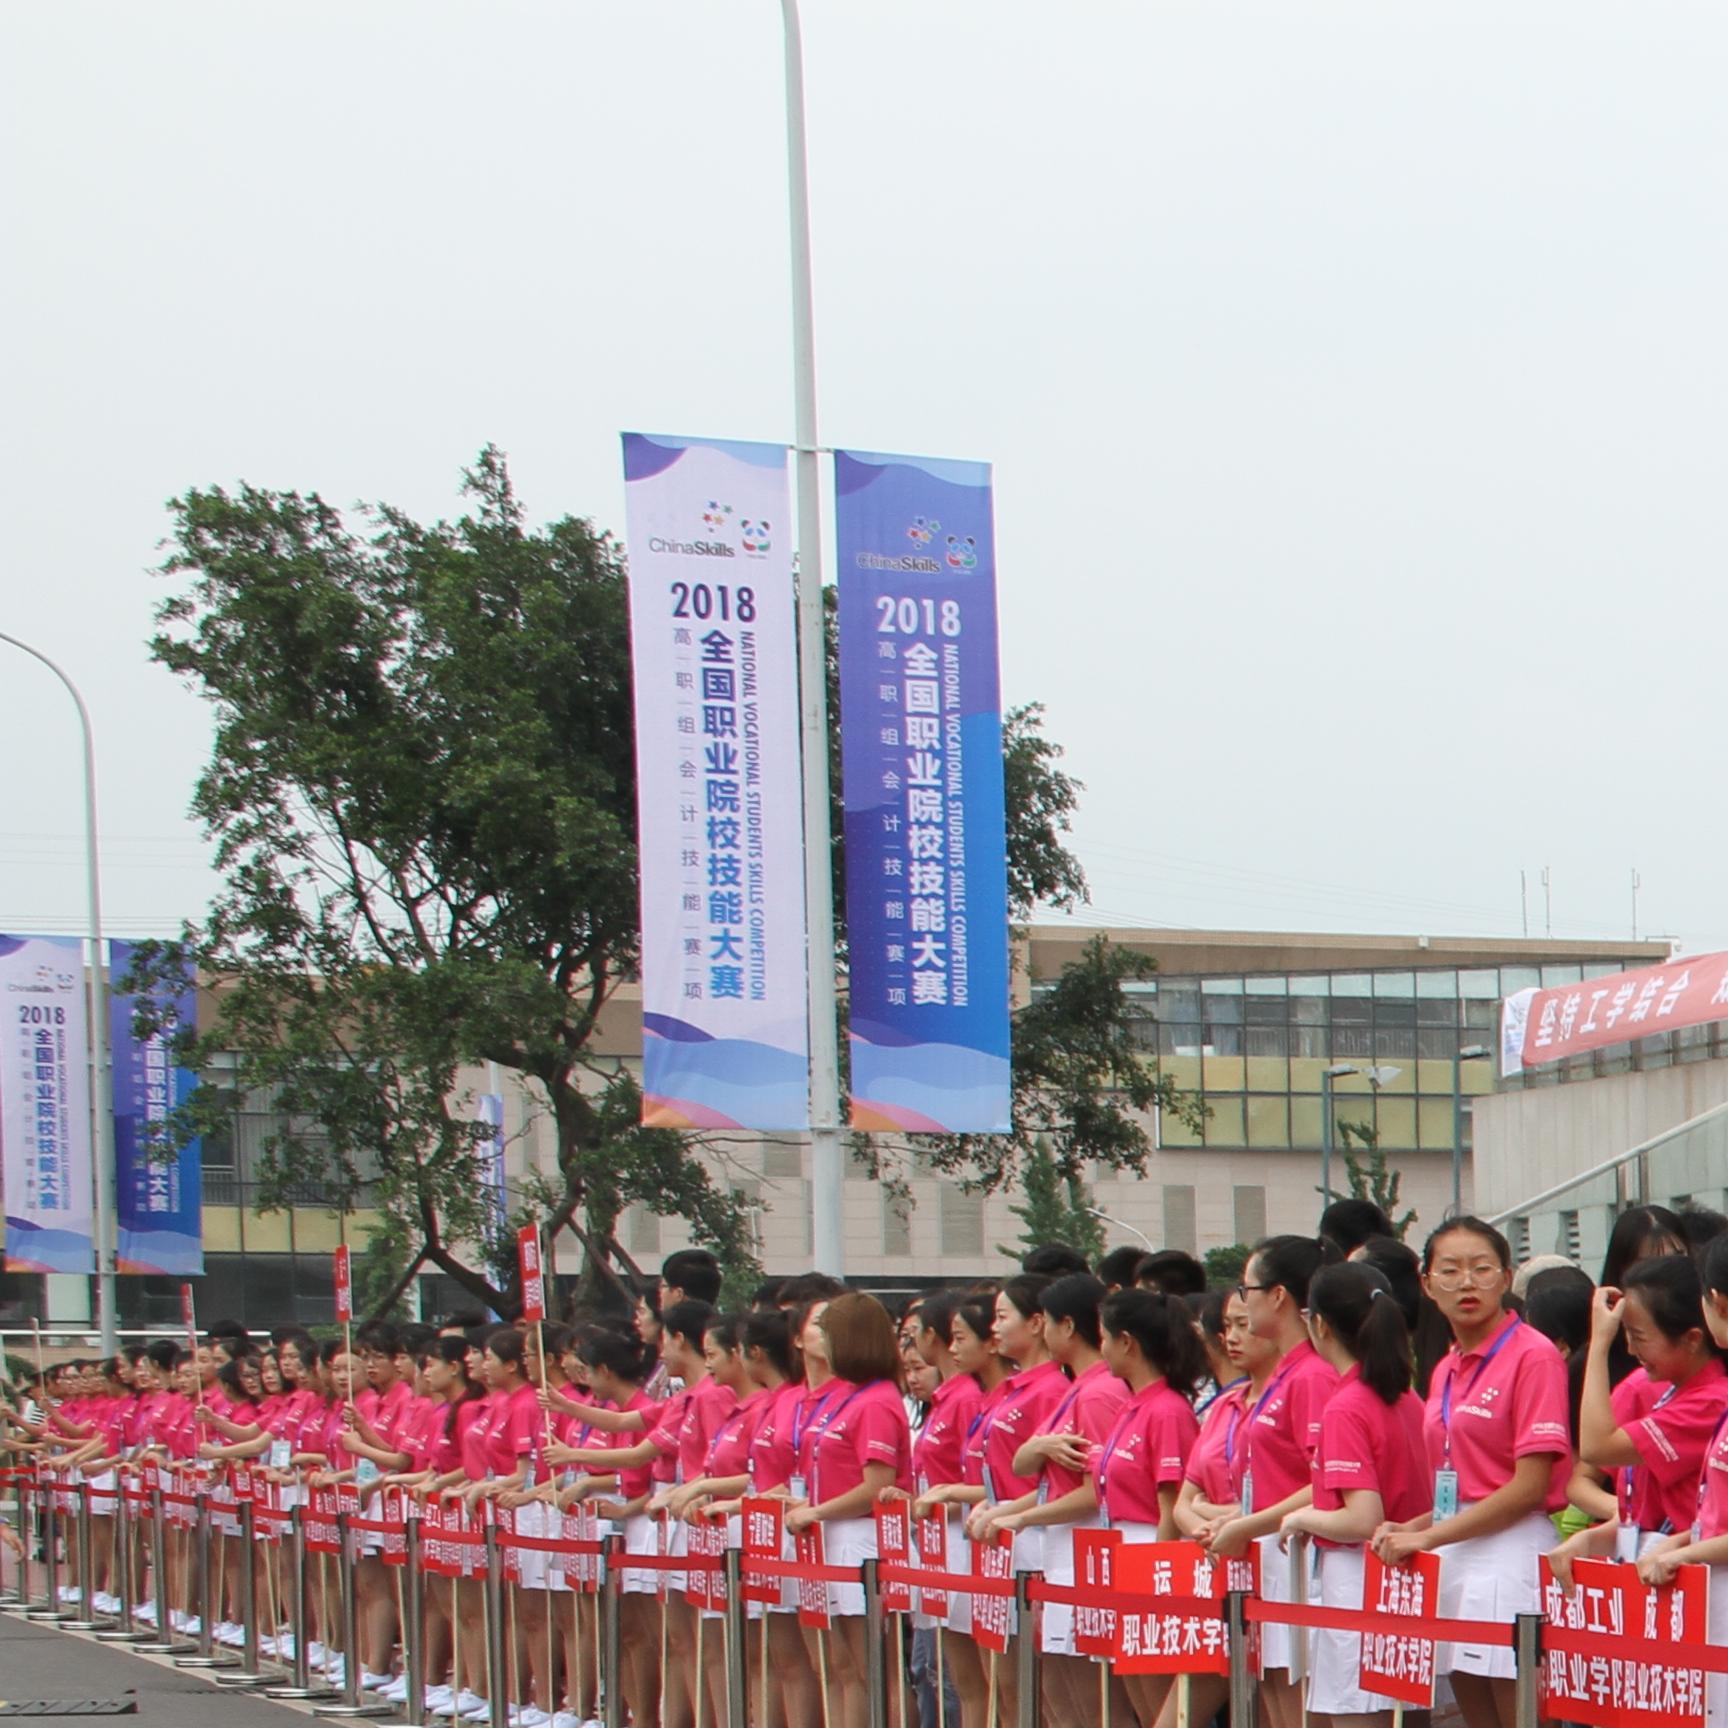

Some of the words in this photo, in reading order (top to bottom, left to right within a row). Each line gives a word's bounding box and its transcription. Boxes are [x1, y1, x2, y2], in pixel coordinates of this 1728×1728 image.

[649, 538, 736, 558] ChinaSkills
[857, 553, 941, 574] ChinaSkills
[671, 582, 757, 623] 2018
[876, 596, 962, 638] 2018
[741, 631, 757, 698] NATIONAL
[943, 643, 960, 709] NATIONAL
[743, 702, 761, 787] VOCATIONAL
[944, 713, 963, 797] VOCATIONAL
[700, 629, 745, 999] 全国职业院校技能大赛
[746, 792, 763, 858] STUDENTS
[903, 643, 948, 1006] 全国职业院校技能大赛
[949, 801, 966, 867] STUDENTS
[748, 862, 764, 905] SKILLS
[950, 870, 967, 913] SKILLS
[750, 908, 766, 1001] COMPETITION
[952, 916, 969, 1007] COMPETITION
[19, 1005, 65, 1025] 2018
[1534, 968, 1692, 1048] 坚持工学结合
[1153, 1557, 1213, 1599] 运城
[1644, 1587, 1684, 1642] 成都
[1362, 1632, 1431, 1686] 职业技术学院
[1624, 1660, 1703, 1716] 职业技术学院
